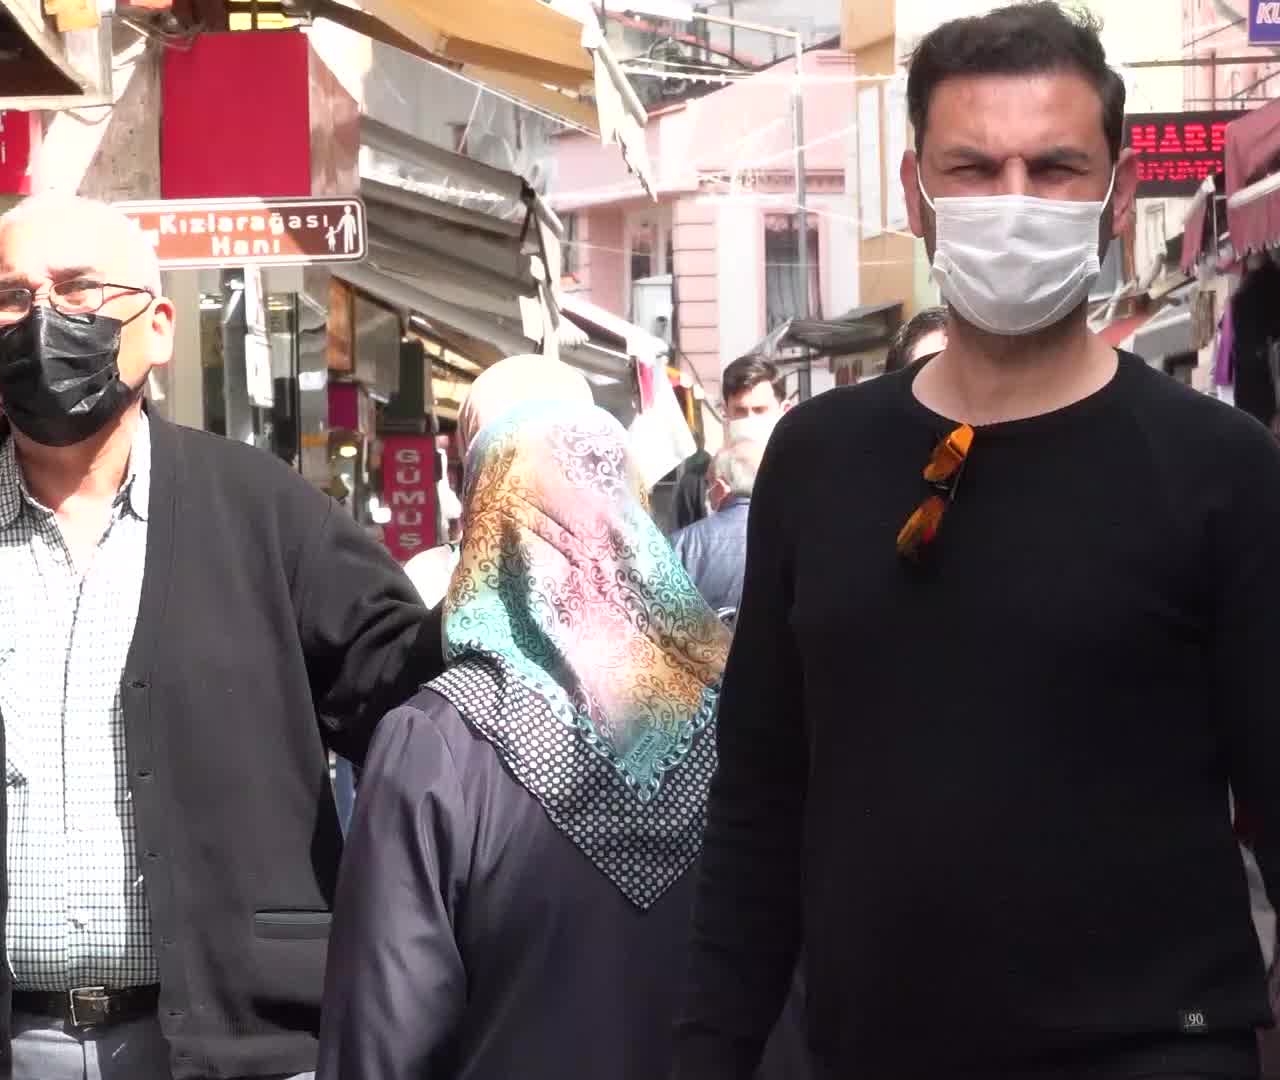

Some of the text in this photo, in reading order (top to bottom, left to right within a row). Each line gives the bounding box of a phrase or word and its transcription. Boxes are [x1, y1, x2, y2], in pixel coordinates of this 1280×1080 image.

[159, 212, 329, 235] Kızlarağası
[211, 236, 281, 256] Hanı
[393, 448, 426, 549] GÜMÜŞ
